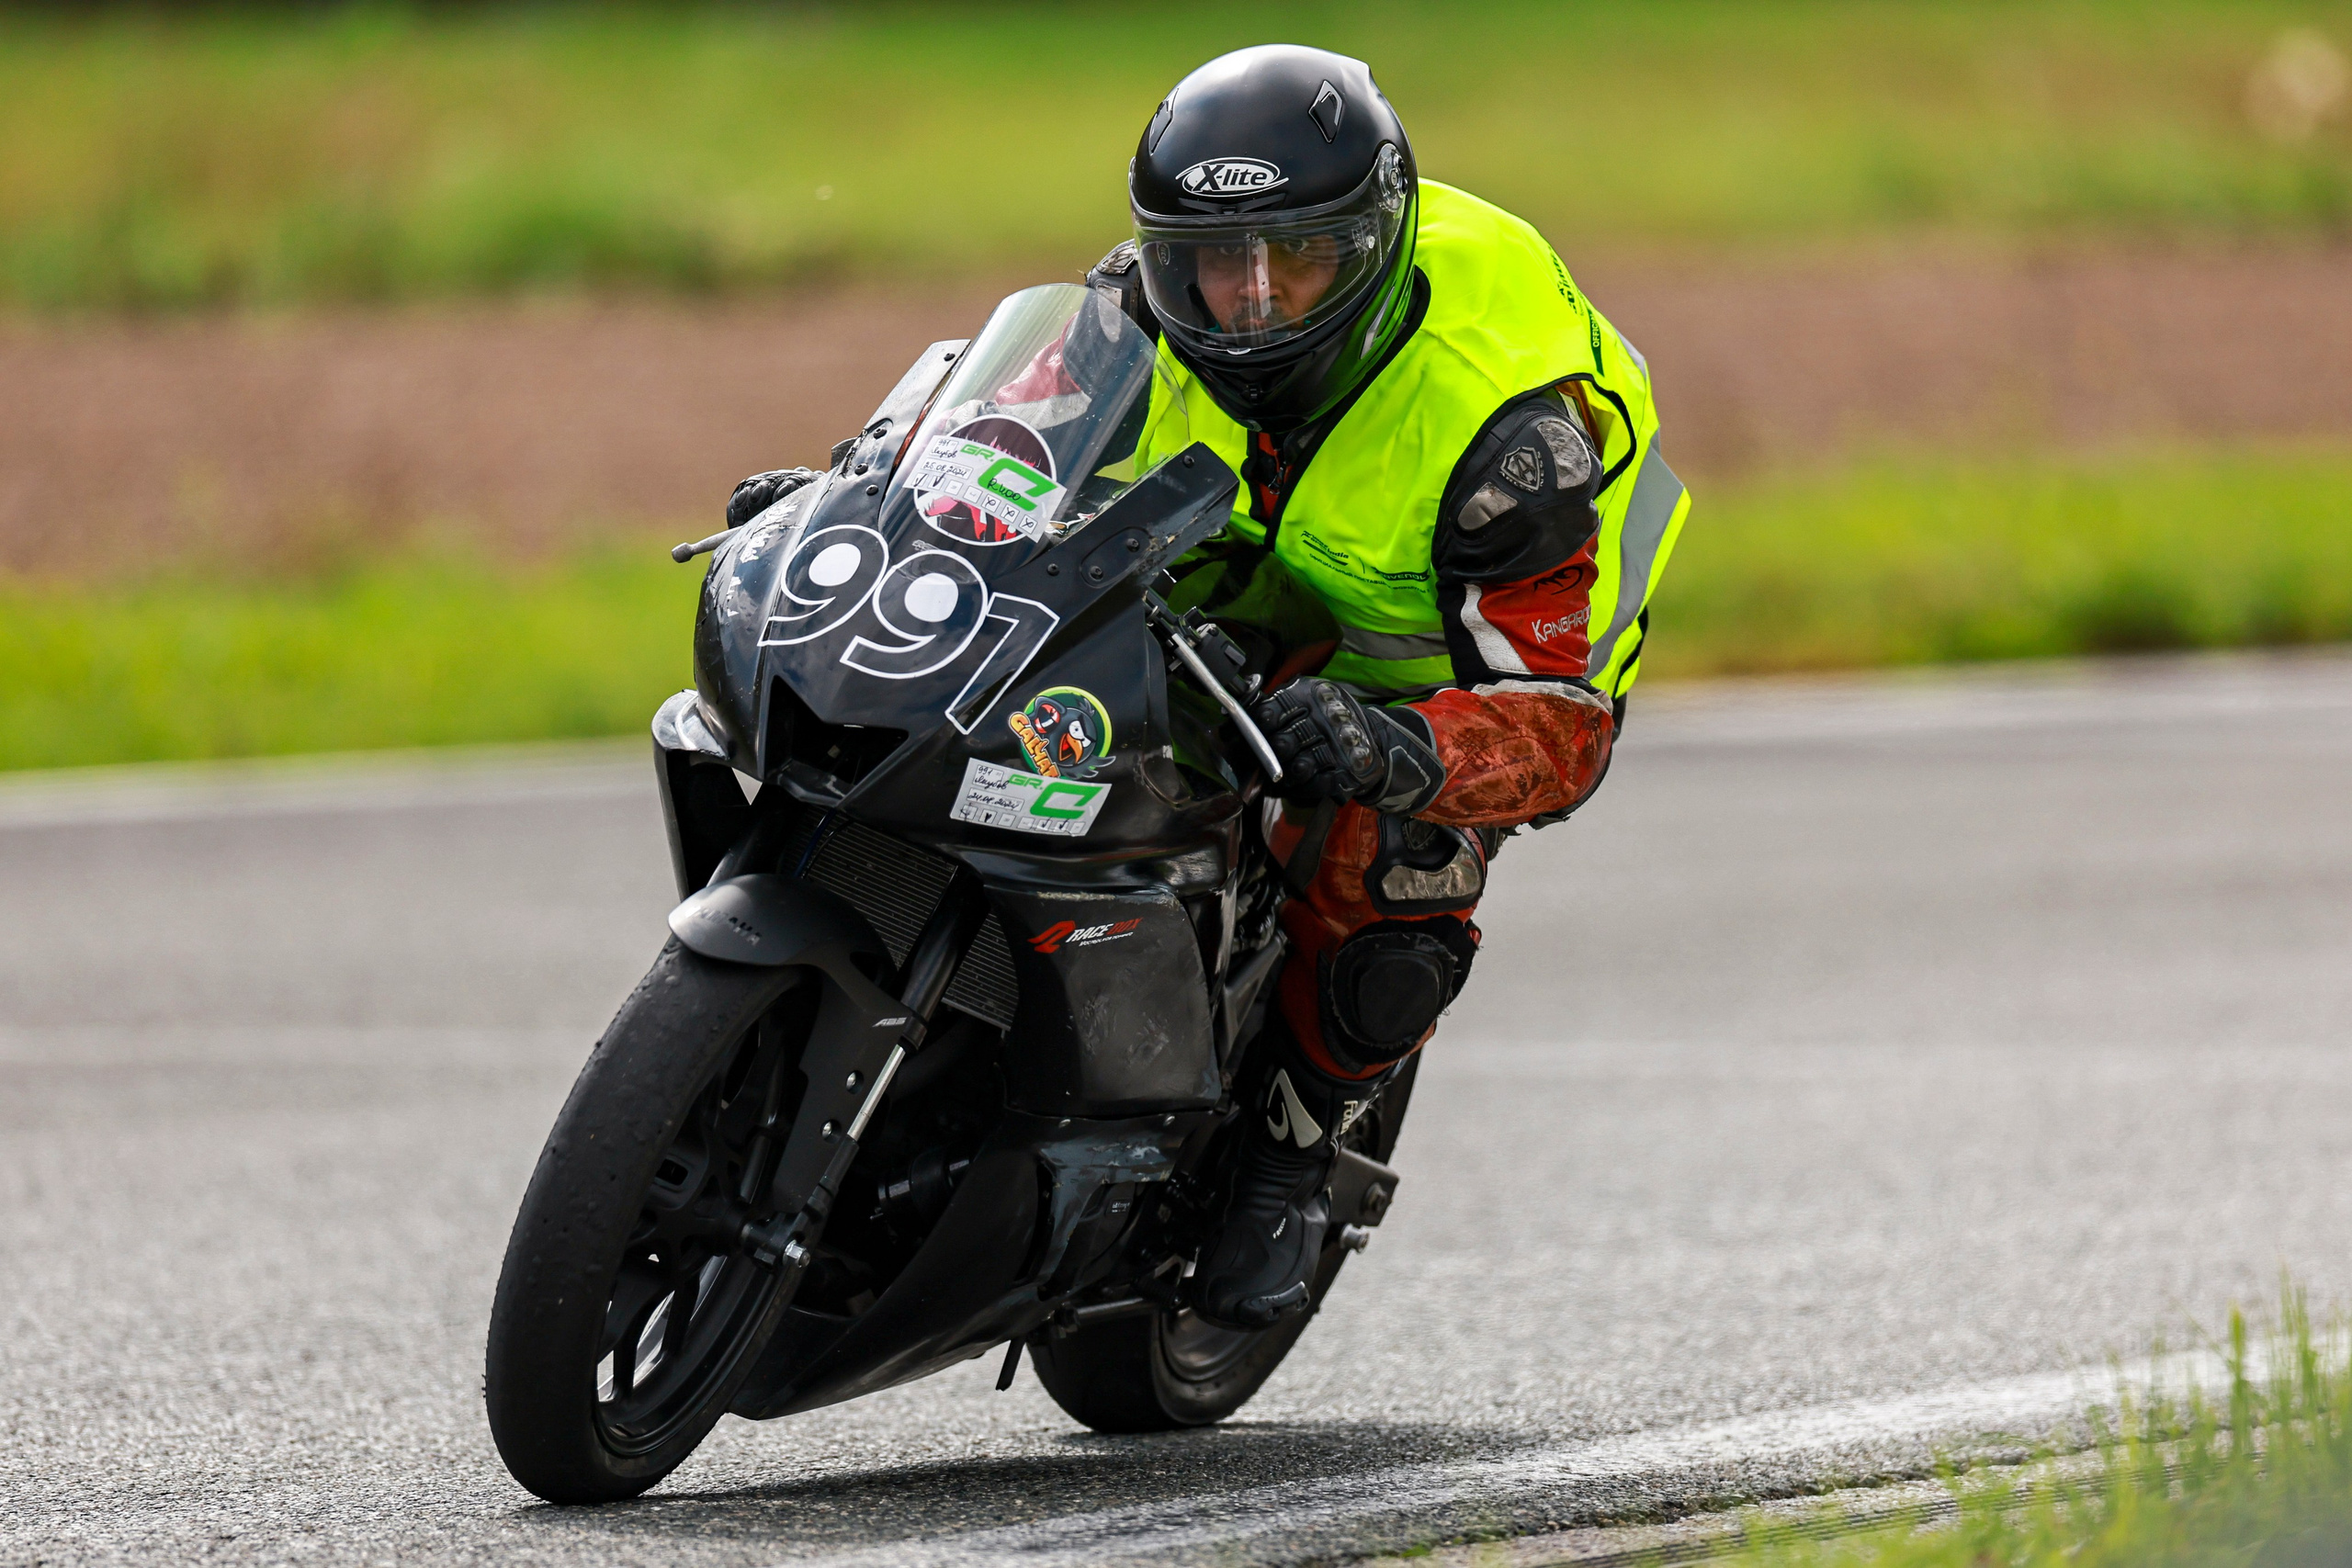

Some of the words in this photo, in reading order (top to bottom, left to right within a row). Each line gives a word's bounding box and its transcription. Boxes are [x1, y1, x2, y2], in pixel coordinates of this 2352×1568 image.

[1193, 164, 1268, 192] X-lite
[960, 444, 995, 462] GR.
[978, 457, 1058, 512] C
[757, 524, 1060, 735] 991
[1008, 773, 1045, 790] GR.
[1030, 782, 1103, 820] C
[872, 1016, 907, 1027] ABS
